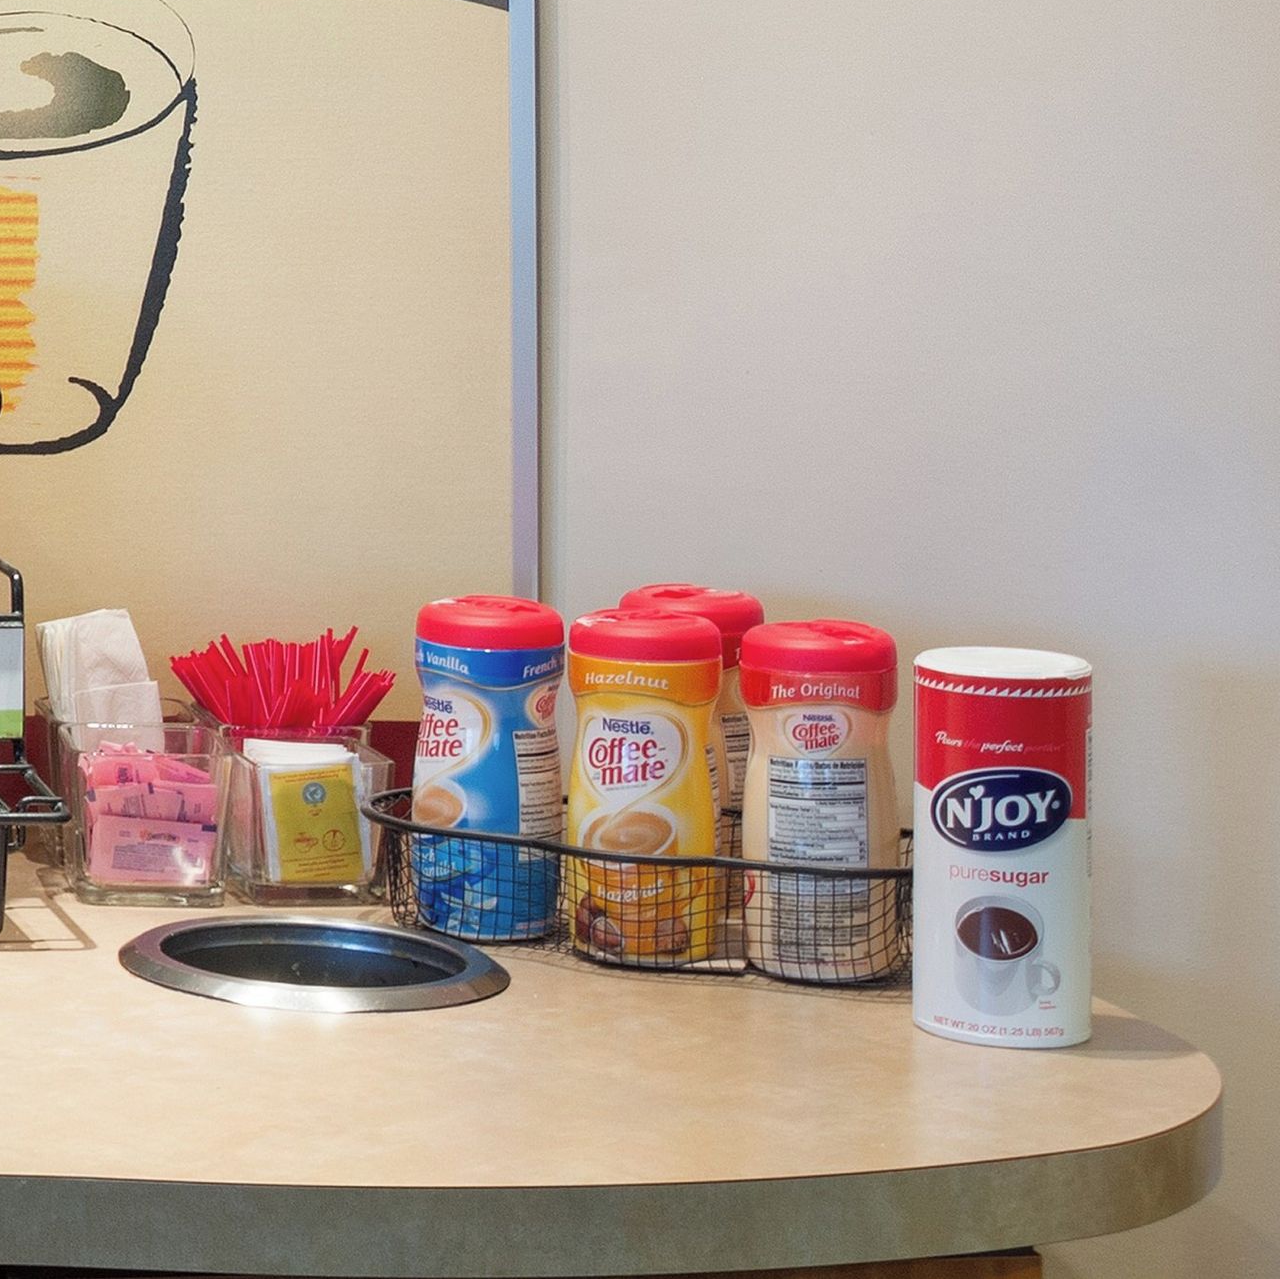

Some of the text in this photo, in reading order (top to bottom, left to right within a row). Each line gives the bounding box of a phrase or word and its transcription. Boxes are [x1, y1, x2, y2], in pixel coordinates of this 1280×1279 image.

[426, 651, 470, 675] Vanilla
[522, 655, 558, 679] French
[585, 670, 669, 690] Hazelnut
[771, 683, 860, 699] The Original
[792, 723, 840, 741] Coffee-
[804, 733, 841, 751] mate
[935, 730, 963, 748] Pours
[980, 739, 1024, 754] perfect
[416, 737, 463, 758] mate
[588, 737, 667, 769] Coffee-
[601, 759, 666, 786] mate
[972, 830, 1031, 841] BRAND
[933, 1015, 948, 1026] NET
[950, 1021, 965, 1030] WT
[967, 1023, 980, 1033] 20
[982, 1025, 997, 1034] OZ
